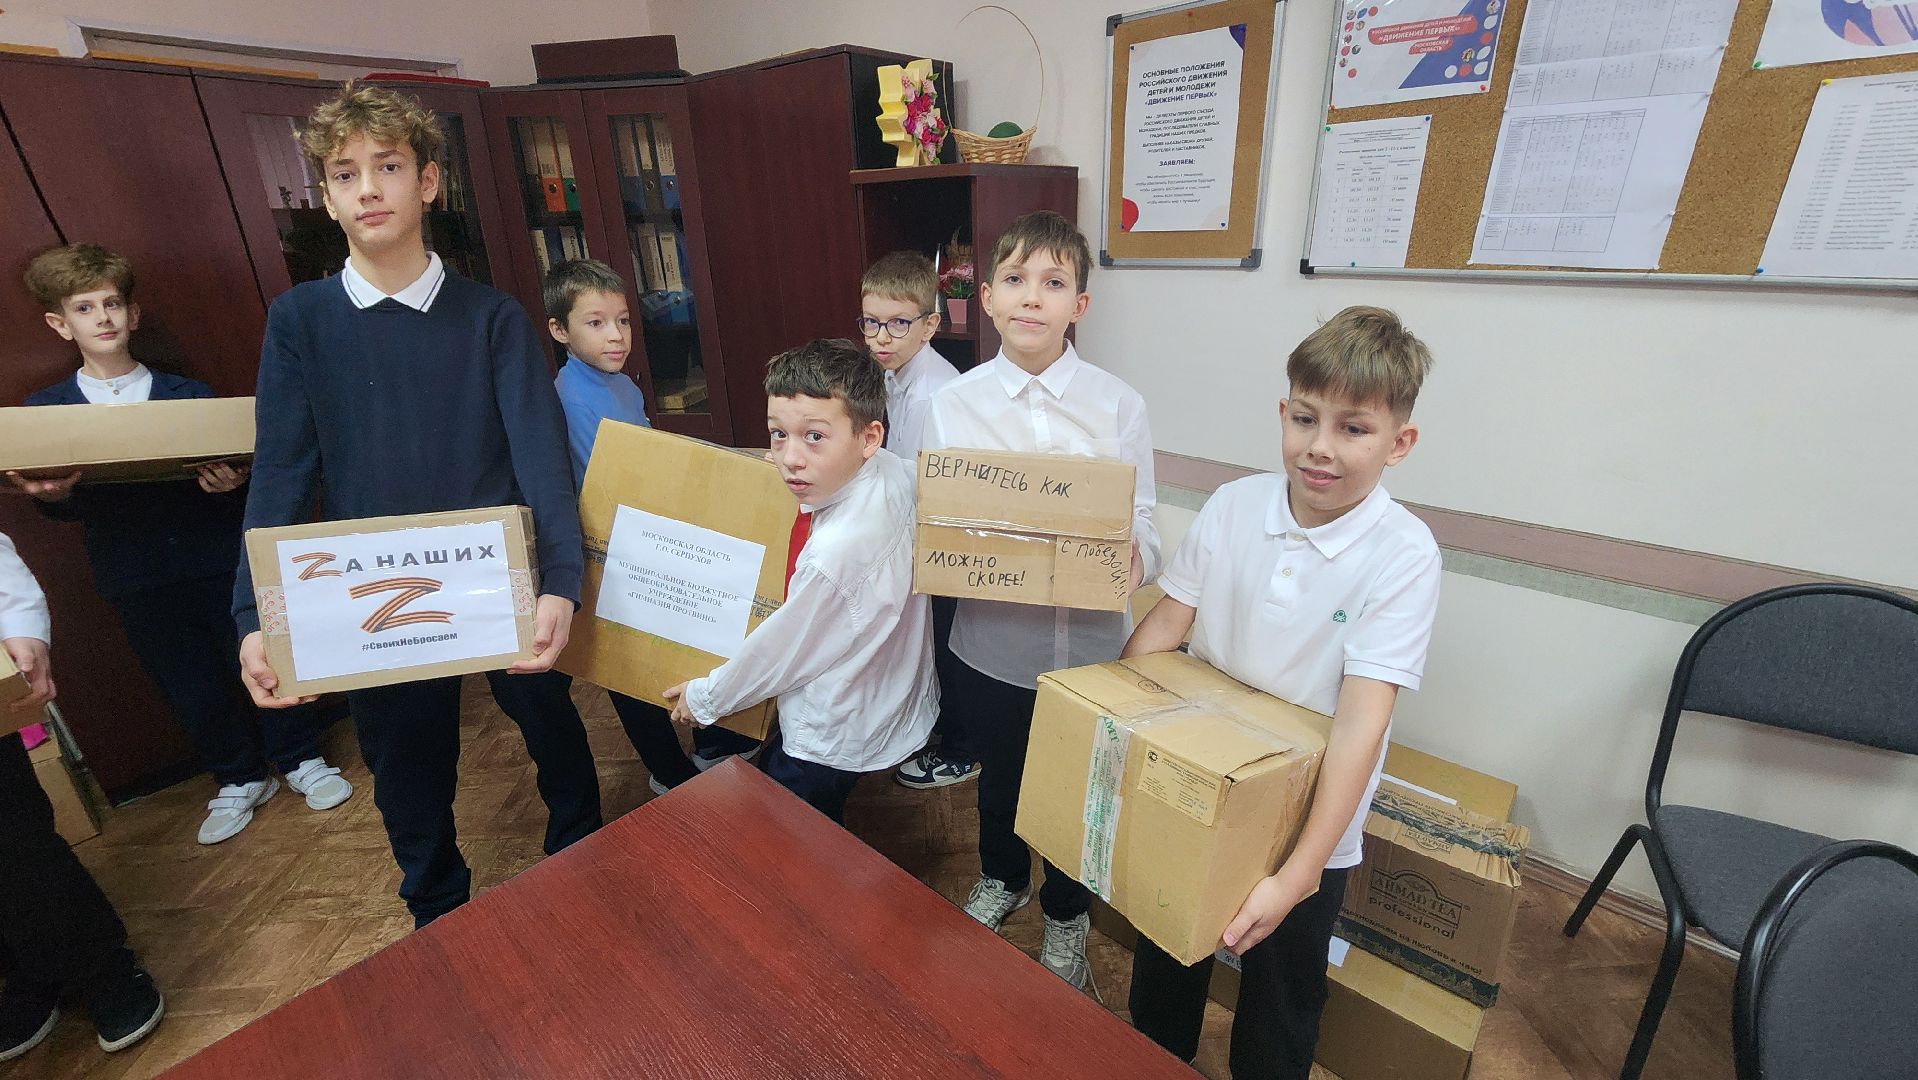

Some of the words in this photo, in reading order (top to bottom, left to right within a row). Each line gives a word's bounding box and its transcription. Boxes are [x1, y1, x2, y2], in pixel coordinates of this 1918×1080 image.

[1139, 75, 1187, 88] РОССИЙСКОГО
[1188, 70, 1228, 82] ДВИЖЕНИЯ
[1142, 67, 1179, 79] ОСНОВНЫЕ
[1180, 60, 1225, 72] ПОЛОЖЕНИЯ
[1145, 95, 1184, 106] «ДВИЖЕНИЕ
[1185, 91, 1217, 101] ПЕРВЫХ»
[1147, 87, 1168, 97] ДЕТЕЙ
[1175, 81, 1216, 92] МОЛОДЕЖИ
[1159, 159, 1196, 167] ЗАЯВЛЯЕМ:
[925, 453, 1028, 492] ВЕРНИТЕСЬ
[1040, 476, 1073, 498] КАК
[641, 530, 694, 551] МОСКОВСКАЯ
[695, 545, 731, 562] ОБЛАСТЬ
[376, 544, 497, 569] НАШИХ
[671, 548, 712, 565] СЕРПУХОВ
[925, 550, 997, 569] МОЖНО
[618, 559, 686, 587] МУНИЦИПАЛЬНОЕ
[687, 581, 740, 602] БЮДЖЕТНОЕ
[967, 570, 1026, 588] СКОРЕЕ!
[627, 573, 723, 608] ОБЩЕОБРАЗОВАТЕЛЬНОЕ
[648, 587, 699, 610] УЧРЕЖДЕНИЕ
[361, 632, 459, 652] #СвоихНеБросаем
[1369, 897, 1456, 939] professional
